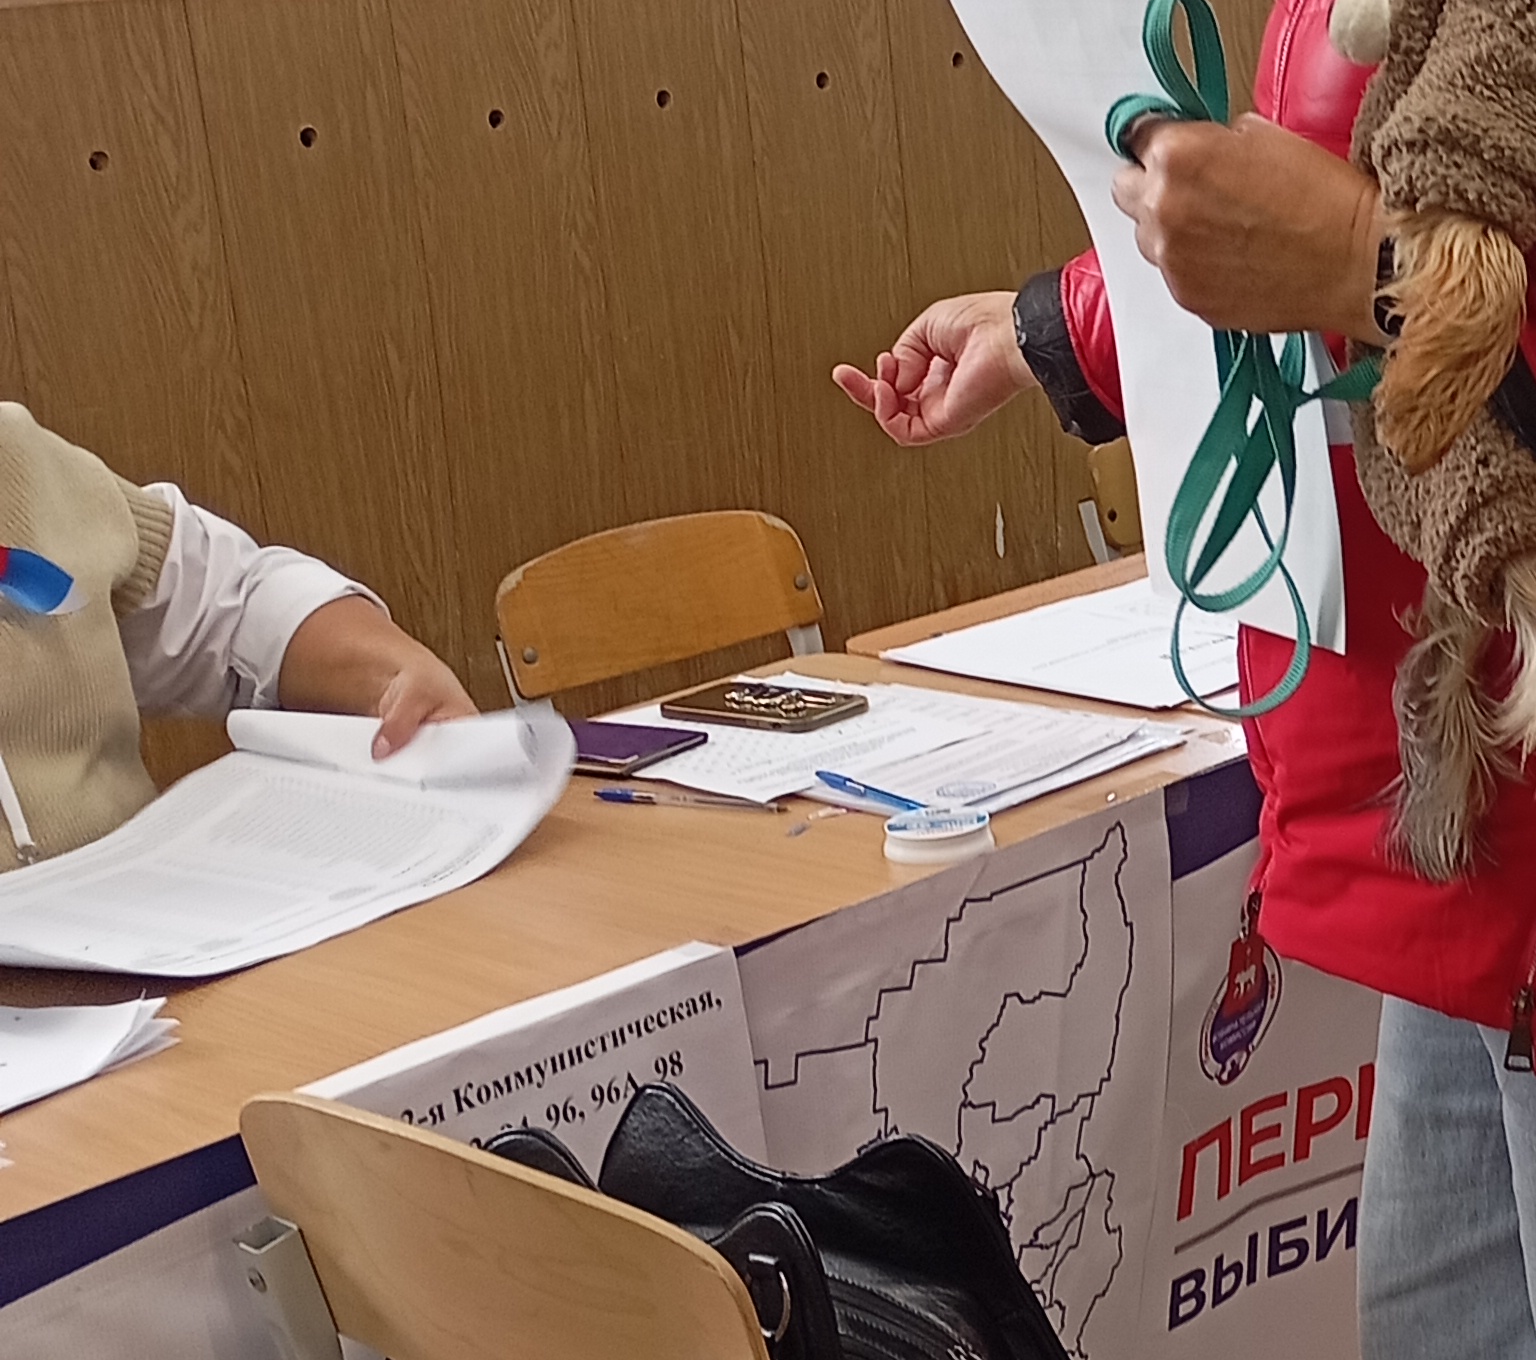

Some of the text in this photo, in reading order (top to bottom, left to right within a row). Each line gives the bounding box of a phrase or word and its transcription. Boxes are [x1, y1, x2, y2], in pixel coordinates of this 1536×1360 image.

[453, 990, 723, 1116] Коммунистическая,
[546, 1096, 586, 1128] 96,
[654, 1050, 684, 1081] 98
[1168, 1197, 1358, 1331] ВЫБИ
